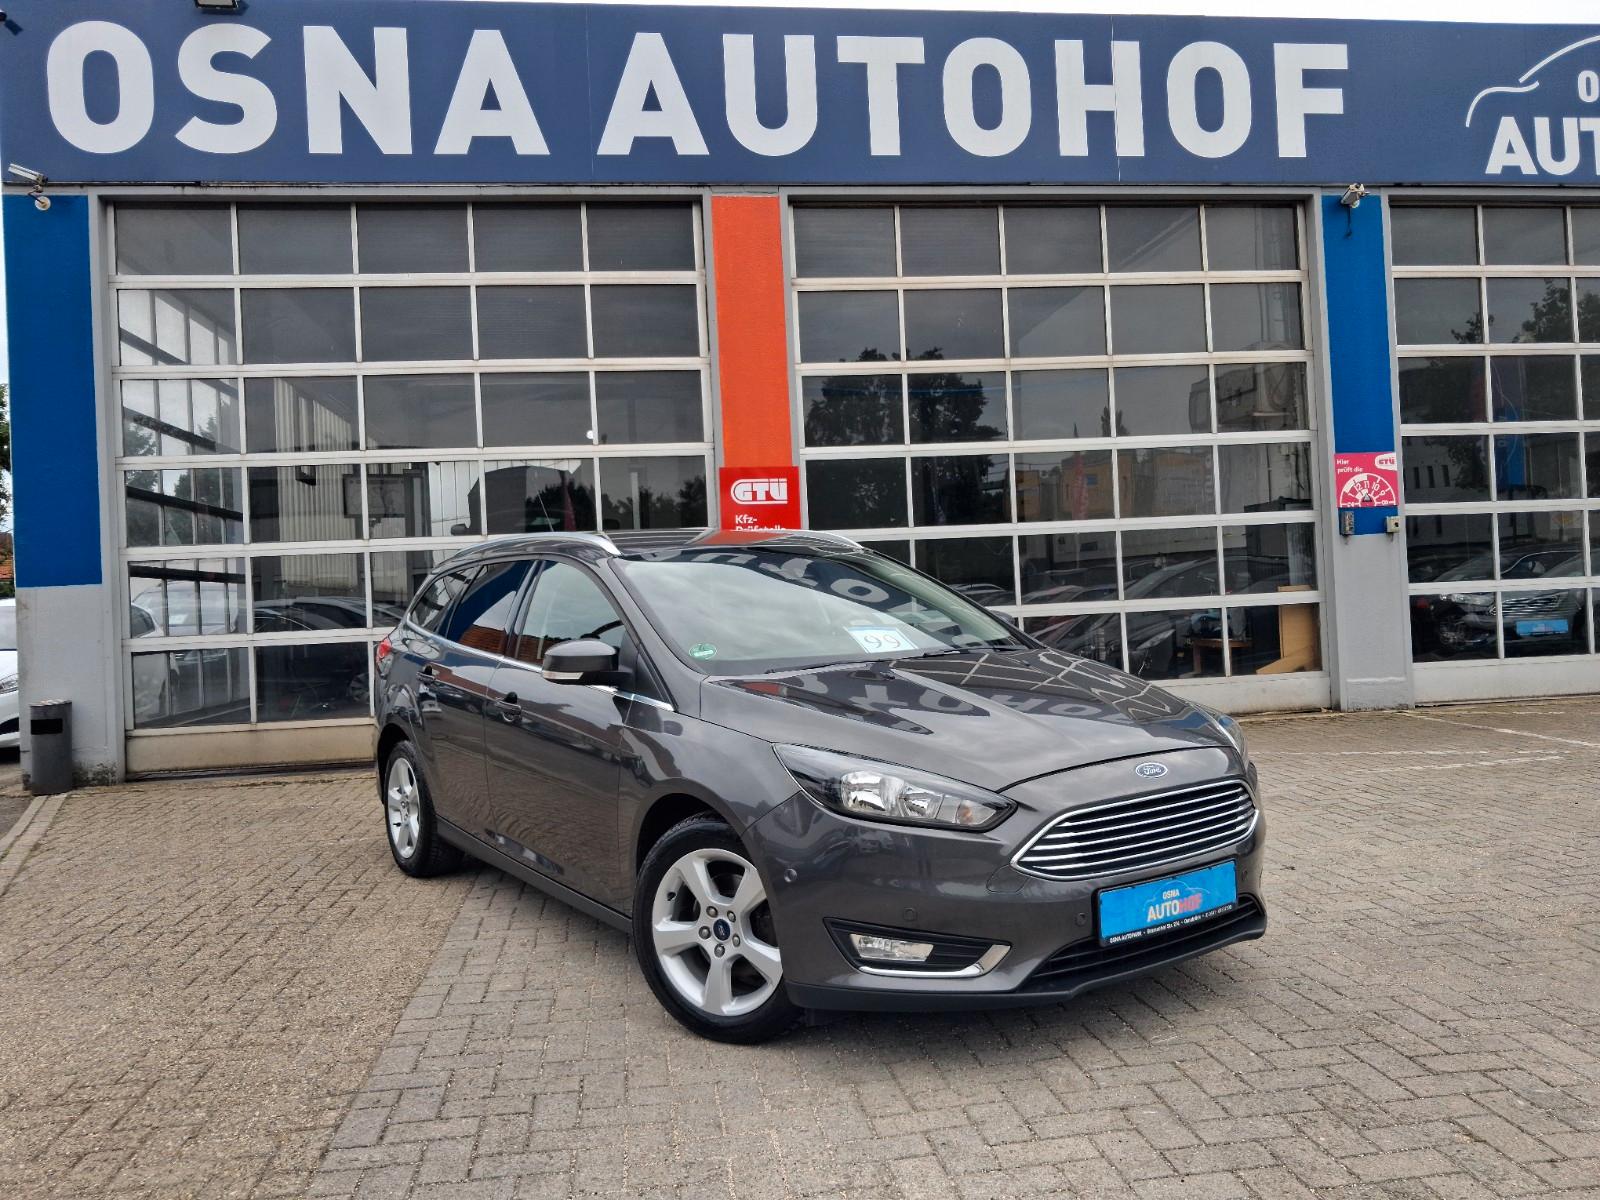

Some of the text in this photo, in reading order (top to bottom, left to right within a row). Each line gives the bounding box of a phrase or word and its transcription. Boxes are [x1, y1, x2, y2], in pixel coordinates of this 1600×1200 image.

[47, 21, 1348, 158] OSNA AUTOHOF
[1337, 466, 1353, 475] prüft
[735, 514, 758, 524] Kfz-
[1162, 889, 1180, 900] OSNA
[1147, 892, 1203, 922] AUTOHOF
